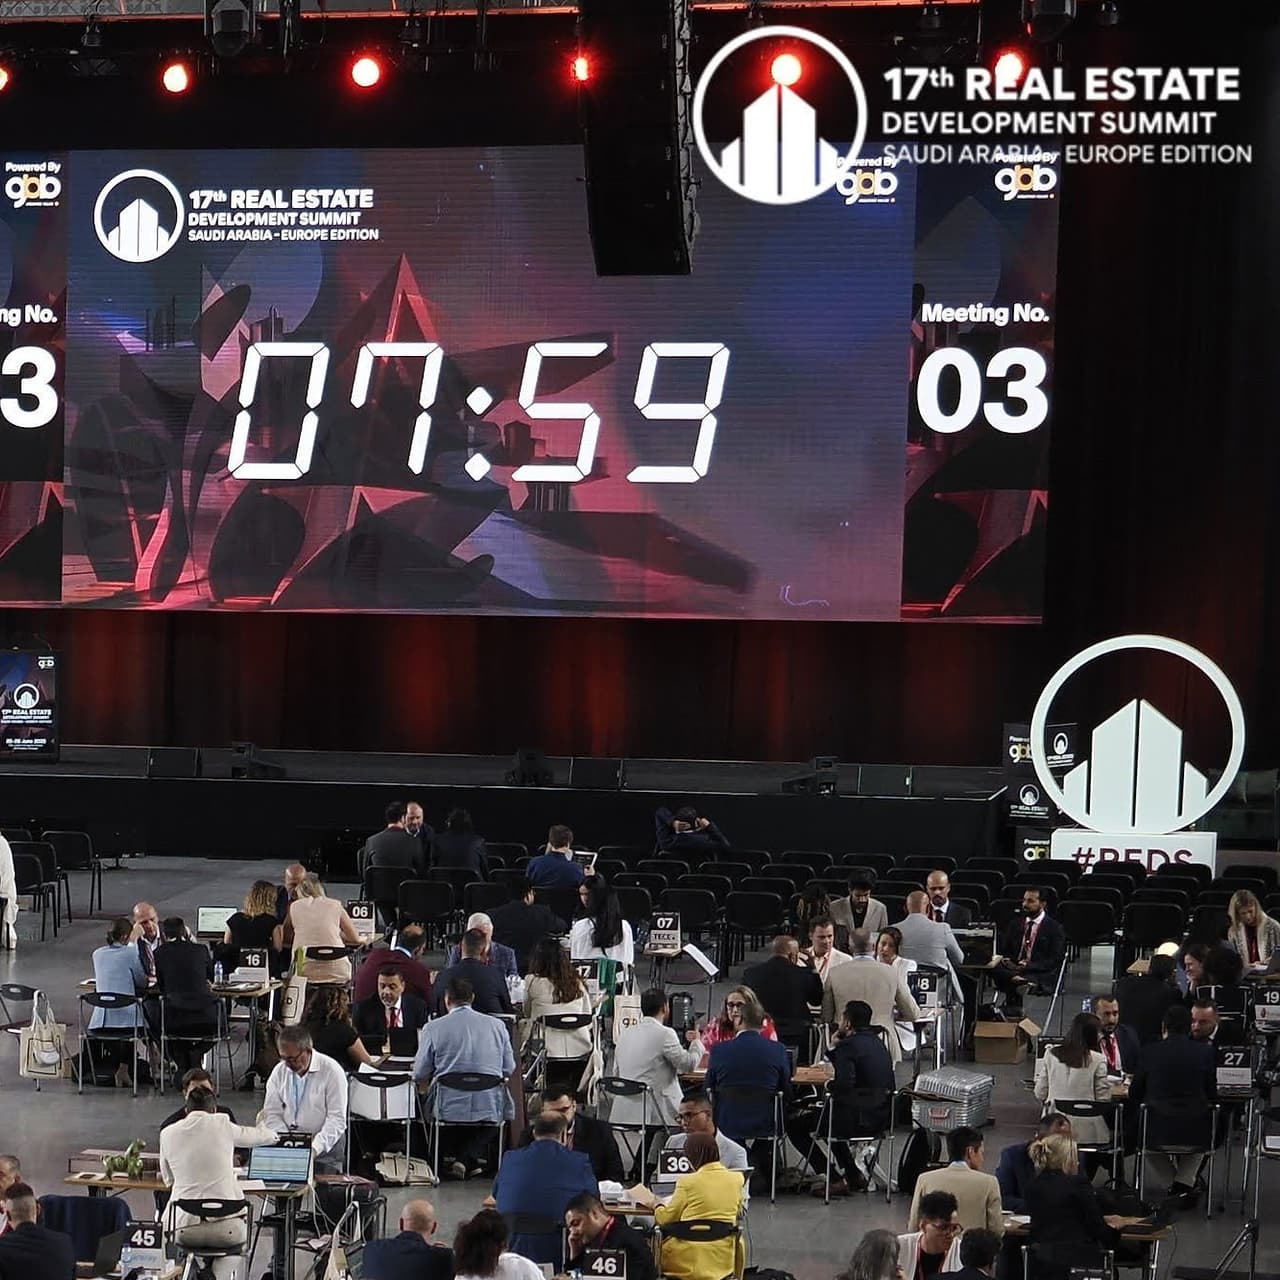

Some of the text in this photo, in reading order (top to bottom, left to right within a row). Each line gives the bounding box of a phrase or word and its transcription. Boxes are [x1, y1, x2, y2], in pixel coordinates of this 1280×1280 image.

[5, 161, 61, 174] Powered By
[5, 173, 62, 209] gbb
[994, 165, 1057, 201] gbb
[189, 189, 374, 209] 17th REAL ESTATE
[188, 211, 361, 226] DEVELOPMENT SUMMIT
[188, 230, 225, 241] SAUDI
[226, 230, 273, 241] ARABIA
[281, 229, 328, 241] EUROPE
[330, 229, 379, 241] EDITION
[24, 304, 58, 323] No.
[921, 303, 1050, 326] Meeting No.
[915, 346, 1049, 434] 03
[227, 342, 730, 482] 07:59
[352, 906, 368, 918] 06
[657, 917, 674, 929] 07
[246, 954, 260, 966] 16
[1224, 1053, 1244, 1065] 27
[667, 1157, 688, 1171] 36
[131, 1230, 155, 1246] 45
[591, 1257, 616, 1273] 46
